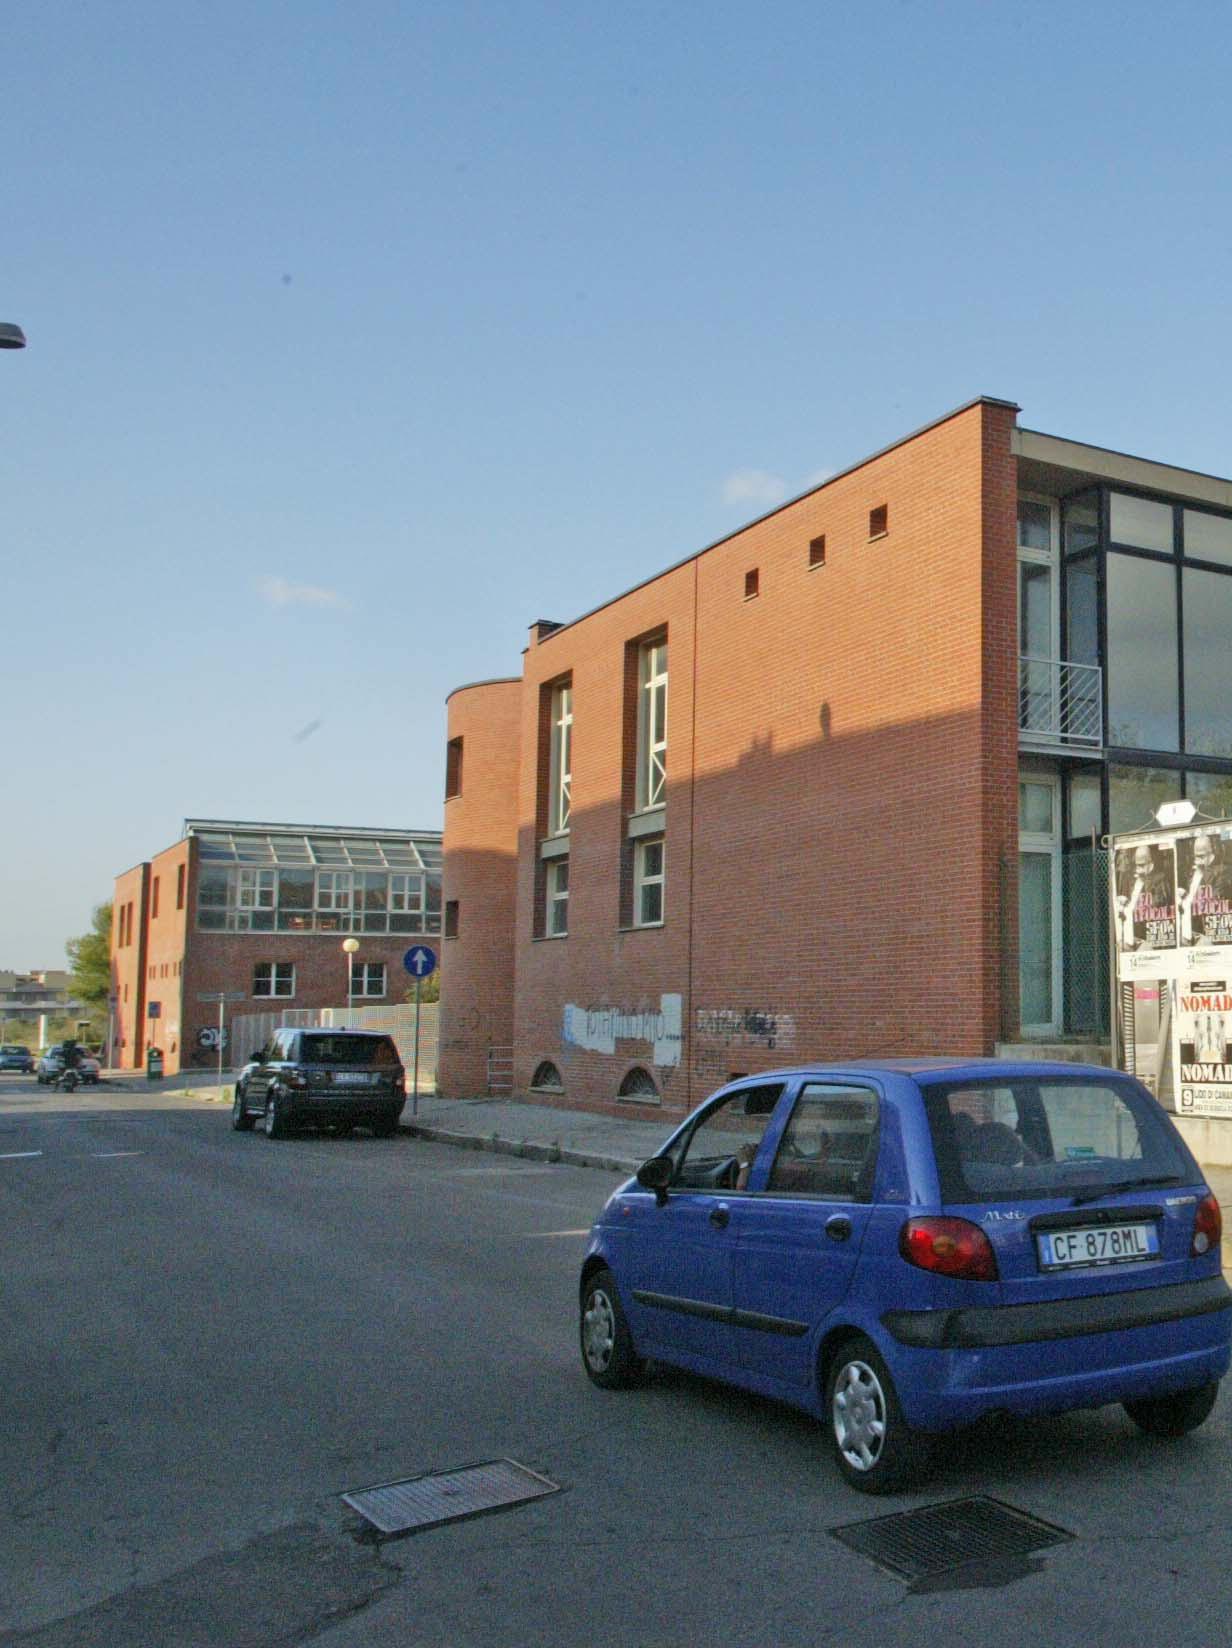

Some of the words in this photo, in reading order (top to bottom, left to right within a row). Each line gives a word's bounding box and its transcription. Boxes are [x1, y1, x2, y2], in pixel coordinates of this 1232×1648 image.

[1146, 919, 1176, 936] SHOW
[1182, 1089, 1193, 1106] 9
[1054, 1234, 1077, 1261] CF
[1085, 1228, 1147, 1257] 878ML
